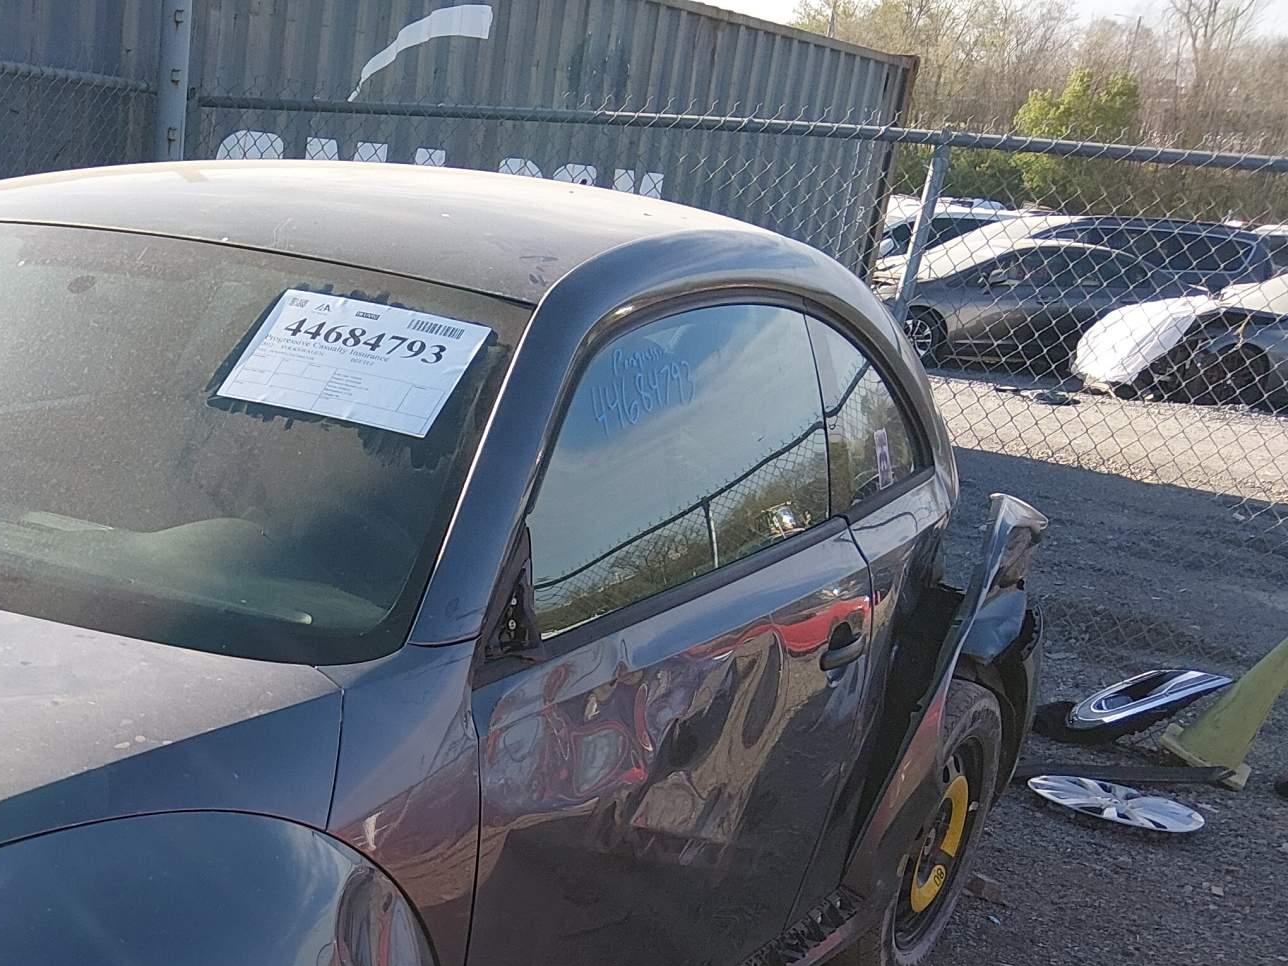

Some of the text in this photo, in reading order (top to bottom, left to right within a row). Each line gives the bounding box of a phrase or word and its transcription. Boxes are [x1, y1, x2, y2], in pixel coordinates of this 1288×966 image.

[284, 317, 447, 364] 44684793
[349, 349, 390, 362] Insurance
[592, 361, 696, 438] 44684793
